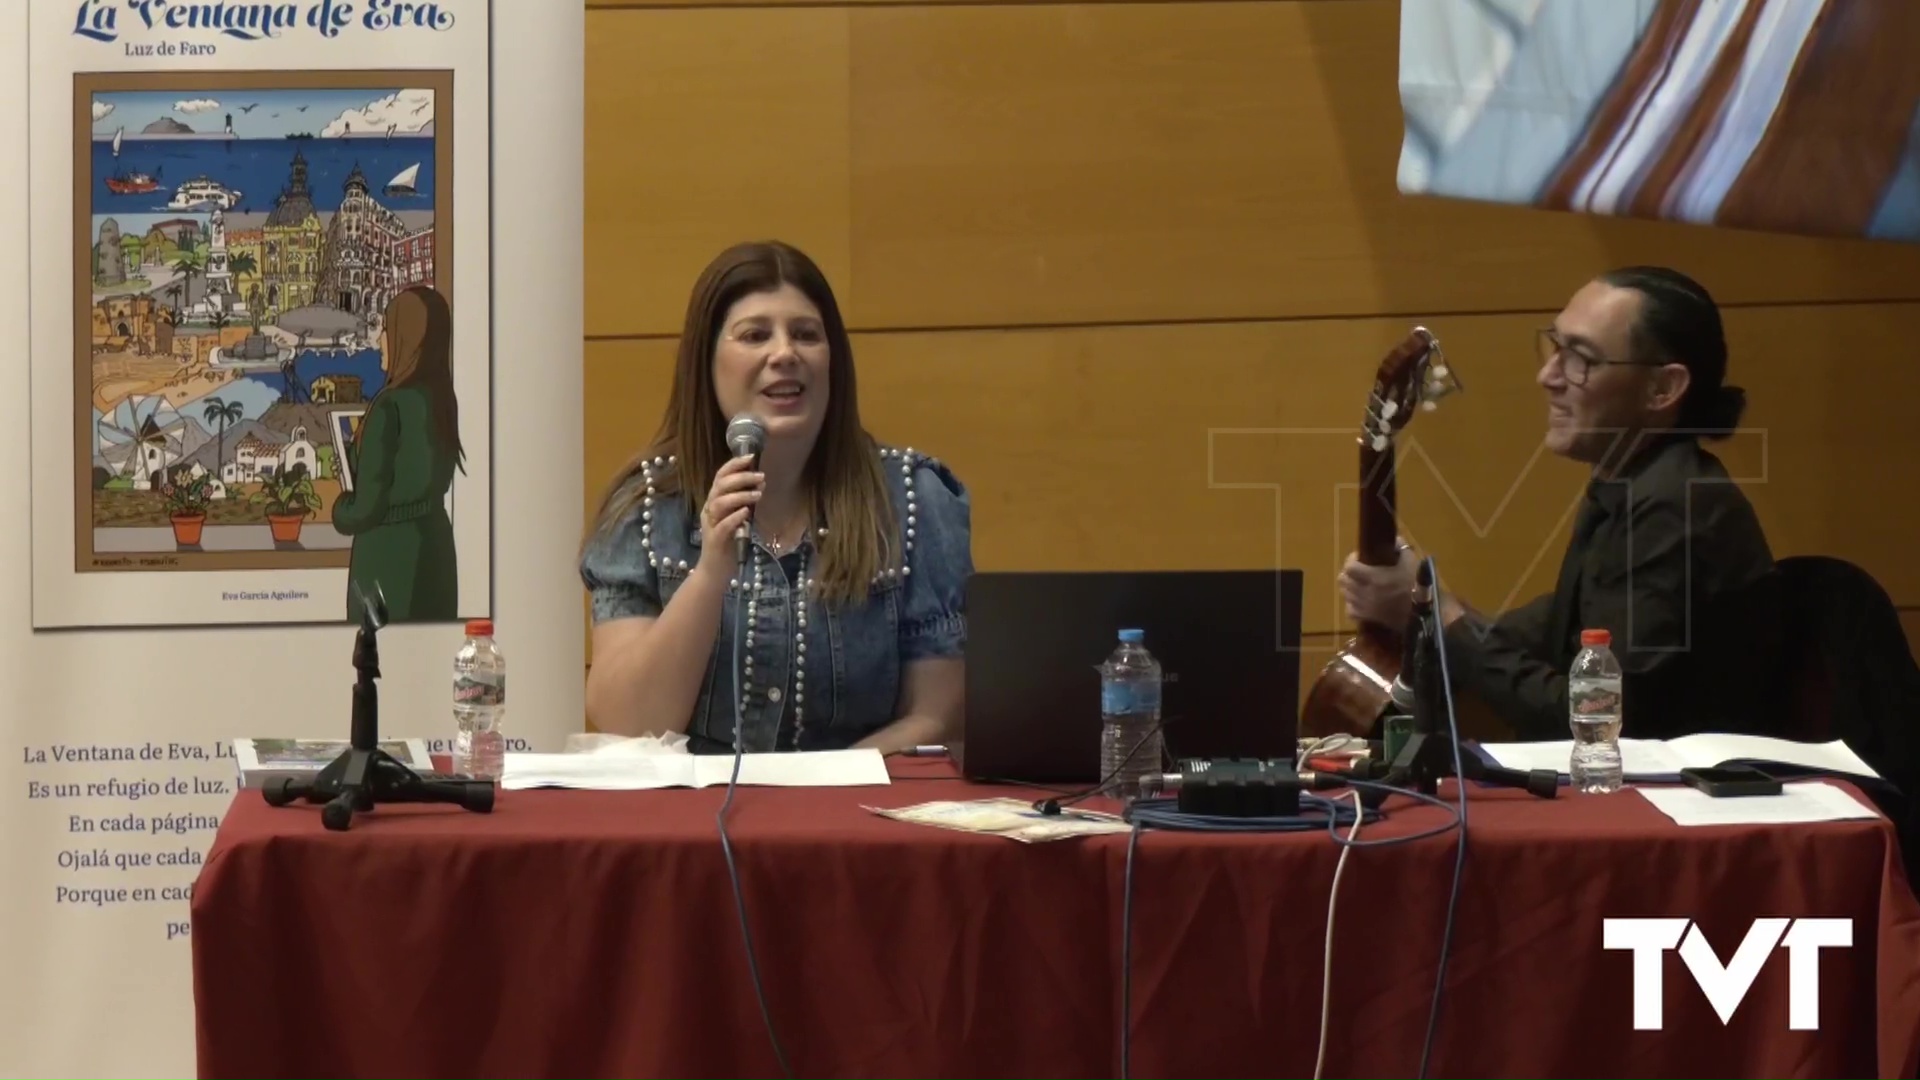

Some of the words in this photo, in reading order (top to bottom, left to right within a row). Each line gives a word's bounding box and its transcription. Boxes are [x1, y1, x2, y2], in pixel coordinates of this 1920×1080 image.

[73, 0, 119, 42] La
[127, 0, 298, 41] Ventana
[306, 0, 354, 38] de
[362, 0, 455, 31] Eva
[124, 42, 153, 57] Luz
[156, 40, 176, 56] de
[179, 41, 217, 56] Faro
[221, 591, 239, 601] Eva
[23, 746, 47, 764] La
[51, 744, 136, 763] Ventana
[139, 742, 164, 760] de
[168, 742, 210, 761] Eva,
[215, 741, 236, 759] Lu
[28, 780, 50, 799] Es
[54, 781, 81, 798] un
[86, 777, 160, 801] refugio
[164, 776, 190, 795] de
[193, 776, 230, 795] luz.
[68, 814, 95, 833] En
[99, 813, 146, 832] cada
[150, 811, 219, 836] página
[57, 848, 110, 872] Ojalá
[114, 851, 151, 871] que
[155, 846, 202, 866] cada
[56, 885, 128, 907] Porque
[131, 887, 156, 901] en
[160, 884, 194, 901] cad
